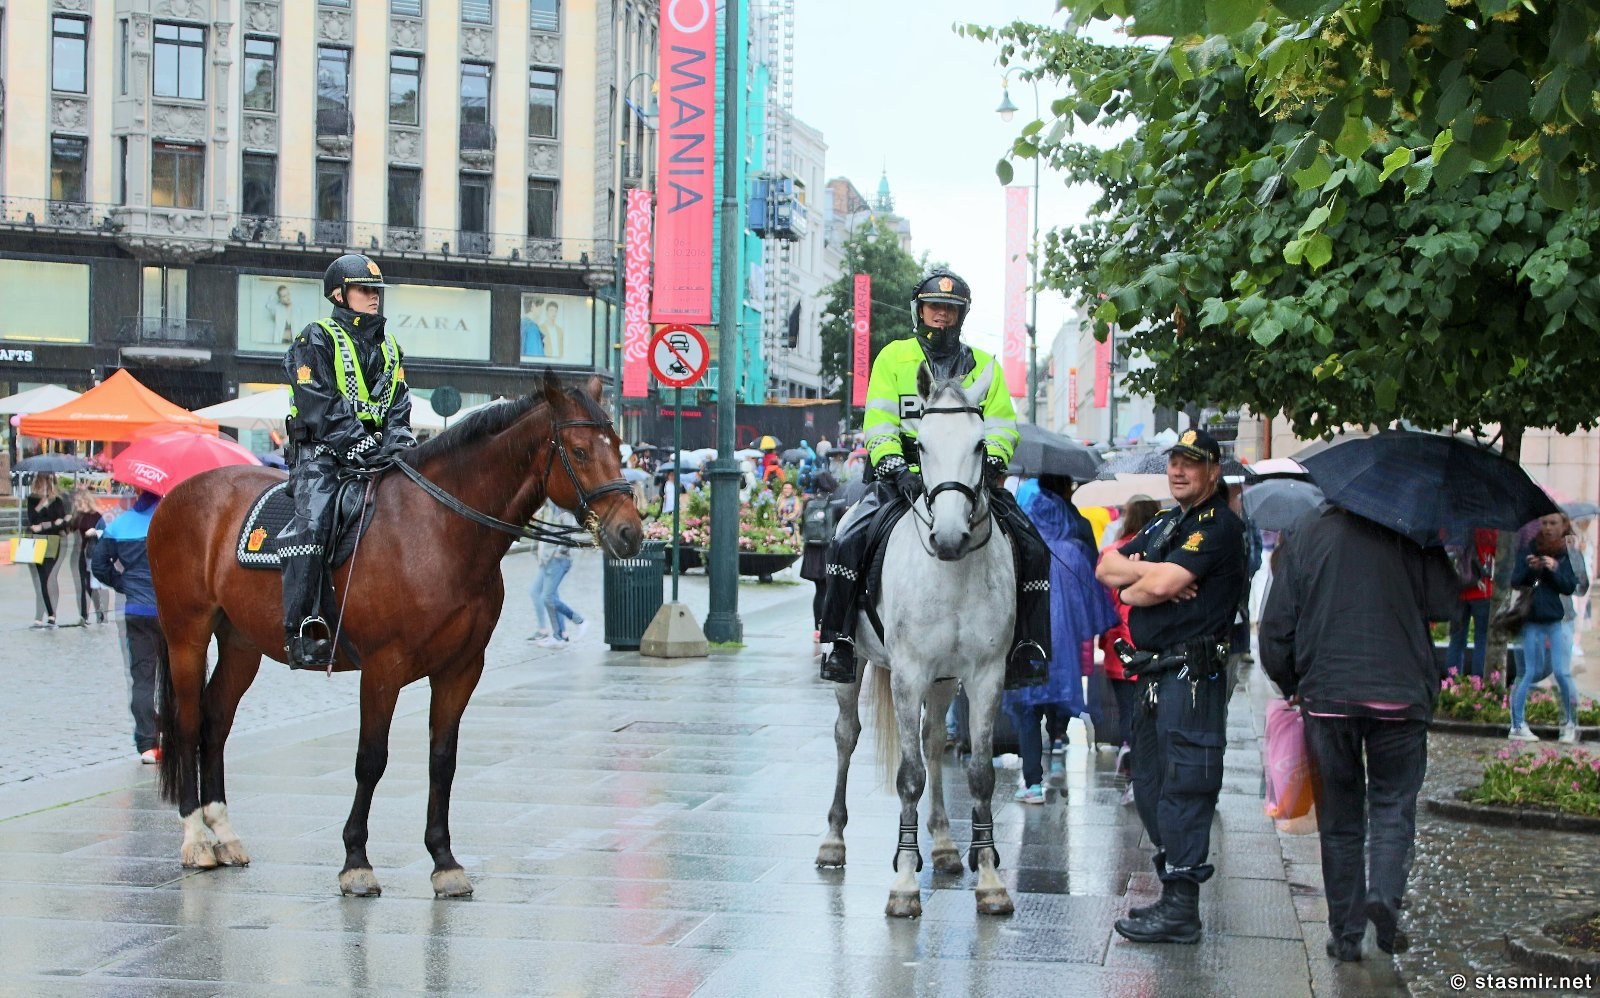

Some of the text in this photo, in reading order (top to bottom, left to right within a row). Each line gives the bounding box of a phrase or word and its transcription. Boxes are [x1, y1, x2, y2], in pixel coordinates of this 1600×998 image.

[668, 45, 706, 214] MANIA
[398, 314, 470, 331] ZARA
[134, 463, 165, 483] THON
